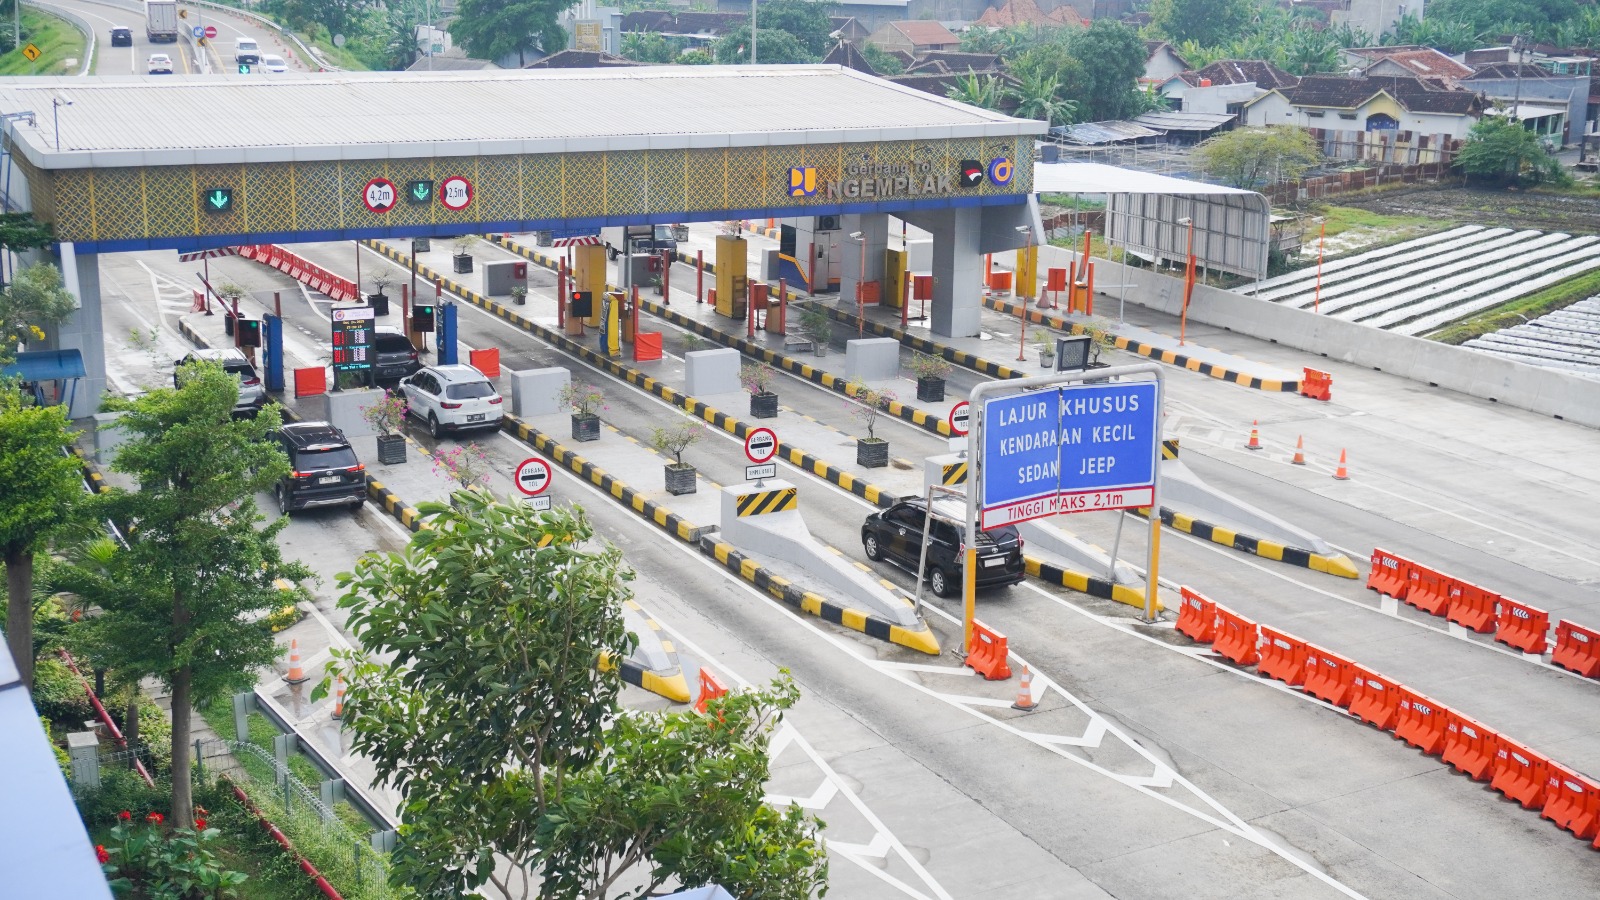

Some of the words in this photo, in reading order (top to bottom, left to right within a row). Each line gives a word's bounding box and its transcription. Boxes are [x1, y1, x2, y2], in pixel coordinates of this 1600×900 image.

[848, 162, 909, 175] Gerbang
[915, 159, 933, 172] Tol
[370, 190, 390, 202] 4,2m
[448, 187, 464, 199] 2,5m
[827, 175, 951, 199] NGEMPLAK
[999, 402, 1047, 427] LAJUR
[1062, 394, 1139, 416] KHUSUS
[1000, 427, 1082, 457] KENDARAAN
[1092, 424, 1136, 443] KECIL
[1018, 460, 1058, 484] SEDAN
[1079, 456, 1116, 475] JEEP
[1007, 500, 1044, 520] TINGGI
[1049, 496, 1086, 512] MAKS
[1094, 493, 1123, 507] 2,1m
